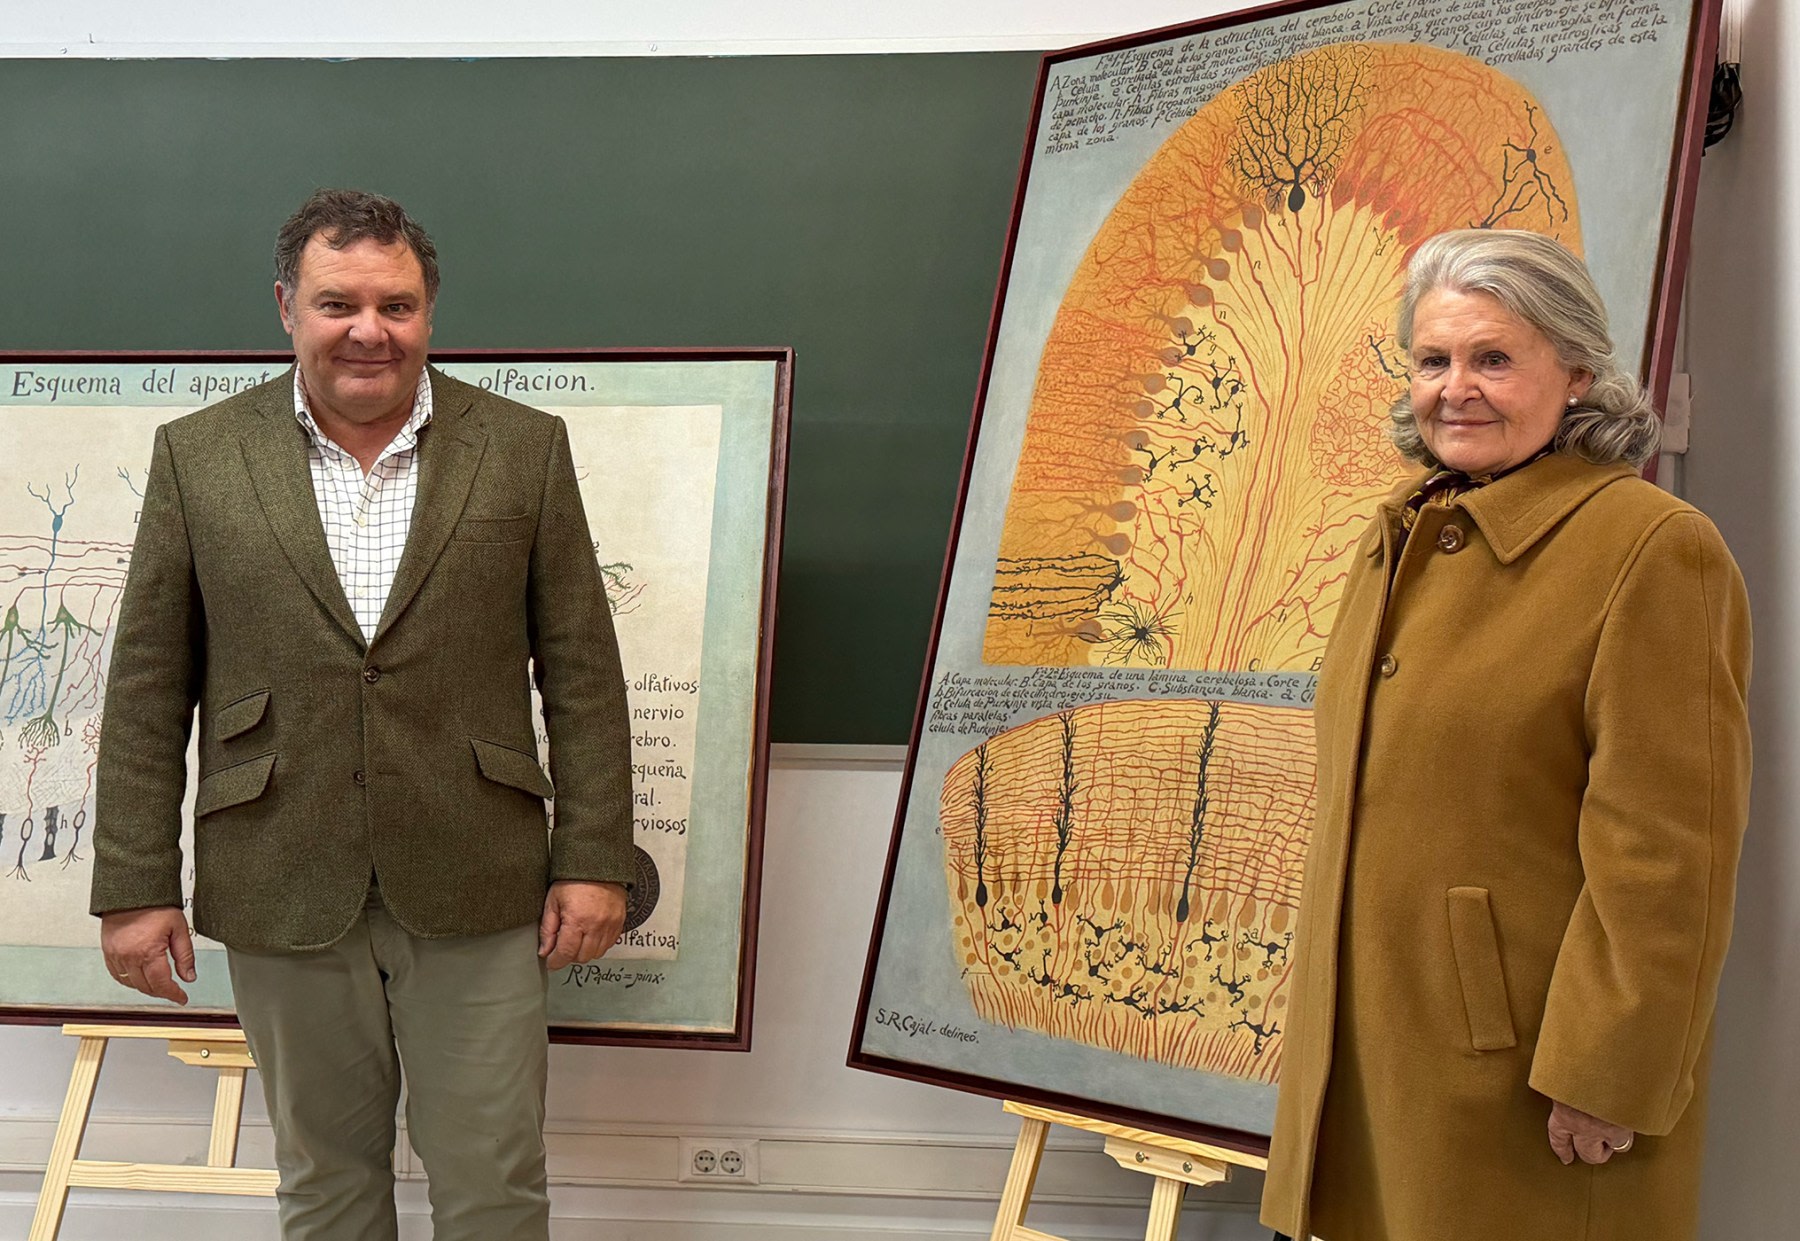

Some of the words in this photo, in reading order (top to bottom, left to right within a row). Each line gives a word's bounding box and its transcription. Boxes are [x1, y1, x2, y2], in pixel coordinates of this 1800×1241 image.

[1429, 23, 1470, 42] Granos
[1475, 18, 1502, 32] cuyo
[1583, 1, 1597, 13] se
[1120, 46, 1174, 70] Esquema
[1181, 40, 1194, 52] de
[1200, 36, 1209, 50] la
[1214, 26, 1275, 46] estructura
[1280, 17, 1300, 32] del
[1306, 8, 1355, 28] cerebelo
[1367, 0, 1406, 16] Corte
[1152, 57, 1174, 71] Capa
[1190, 50, 1202, 62] los
[1366, 14, 1392, 29] Vista
[1395, 10, 1409, 22] de
[1409, 7, 1441, 24] plano
[1446, 2, 1460, 13] de
[1186, 61, 1206, 74] capa
[1369, 22, 1420, 40] nerviosas
[1425, 18, 1449, 34] que
[1449, 9, 1493, 24] rodean
[1496, 4, 1511, 16] los
[1146, 88, 1180, 104] Fibras
[1513, 23, 1527, 35] de
[1530, 12, 1593, 32] neuroglia
[1598, 10, 1615, 21] en
[1617, 3, 1660, 23] forma
[1050, 120, 1061, 131] de
[1122, 103, 1154, 120] Fibras
[1542, 22, 1623, 43] neuroglicas
[1630, 17, 1648, 29] de
[1651, 13, 1668, 25] la
[1048, 129, 1072, 144] capa
[1077, 124, 1089, 136] de
[1092, 121, 1106, 135] los
[1484, 46, 1546, 66] estrelladas
[1546, 37, 1603, 63] grandes
[1608, 33, 1625, 45] de
[1629, 29, 1658, 44] esta
[1045, 139, 1079, 155] misma
[1544, 145, 1553, 155] e
[11, 370, 122, 402] Esquema
[141, 367, 177, 395] del
[189, 369, 277, 401] aparat
[478, 367, 597, 396] olfacion.
[951, 672, 971, 687] Capa
[1032, 678, 1057, 691] Capa
[1062, 680, 1075, 689] de
[1076, 680, 1092, 690] los
[1160, 681, 1225, 697] Substancia
[1058, 667, 1105, 681] Esquema
[1109, 669, 1123, 680] de
[1125, 672, 1145, 681] una
[1266, 674, 1300, 688] Corte
[1000, 687, 1011, 698] de
[1086, 690, 1096, 700] y
[633, 703, 685, 721] nervio
[930, 710, 958, 723] fibras
[973, 699, 983, 708] de
[983, 697, 1027, 714] Purkinje
[1031, 700, 1053, 711] vista
[1057, 700, 1075, 709] de
[63, 720, 73, 737] b
[957, 723, 968, 735] de
[60, 813, 69, 830] h
